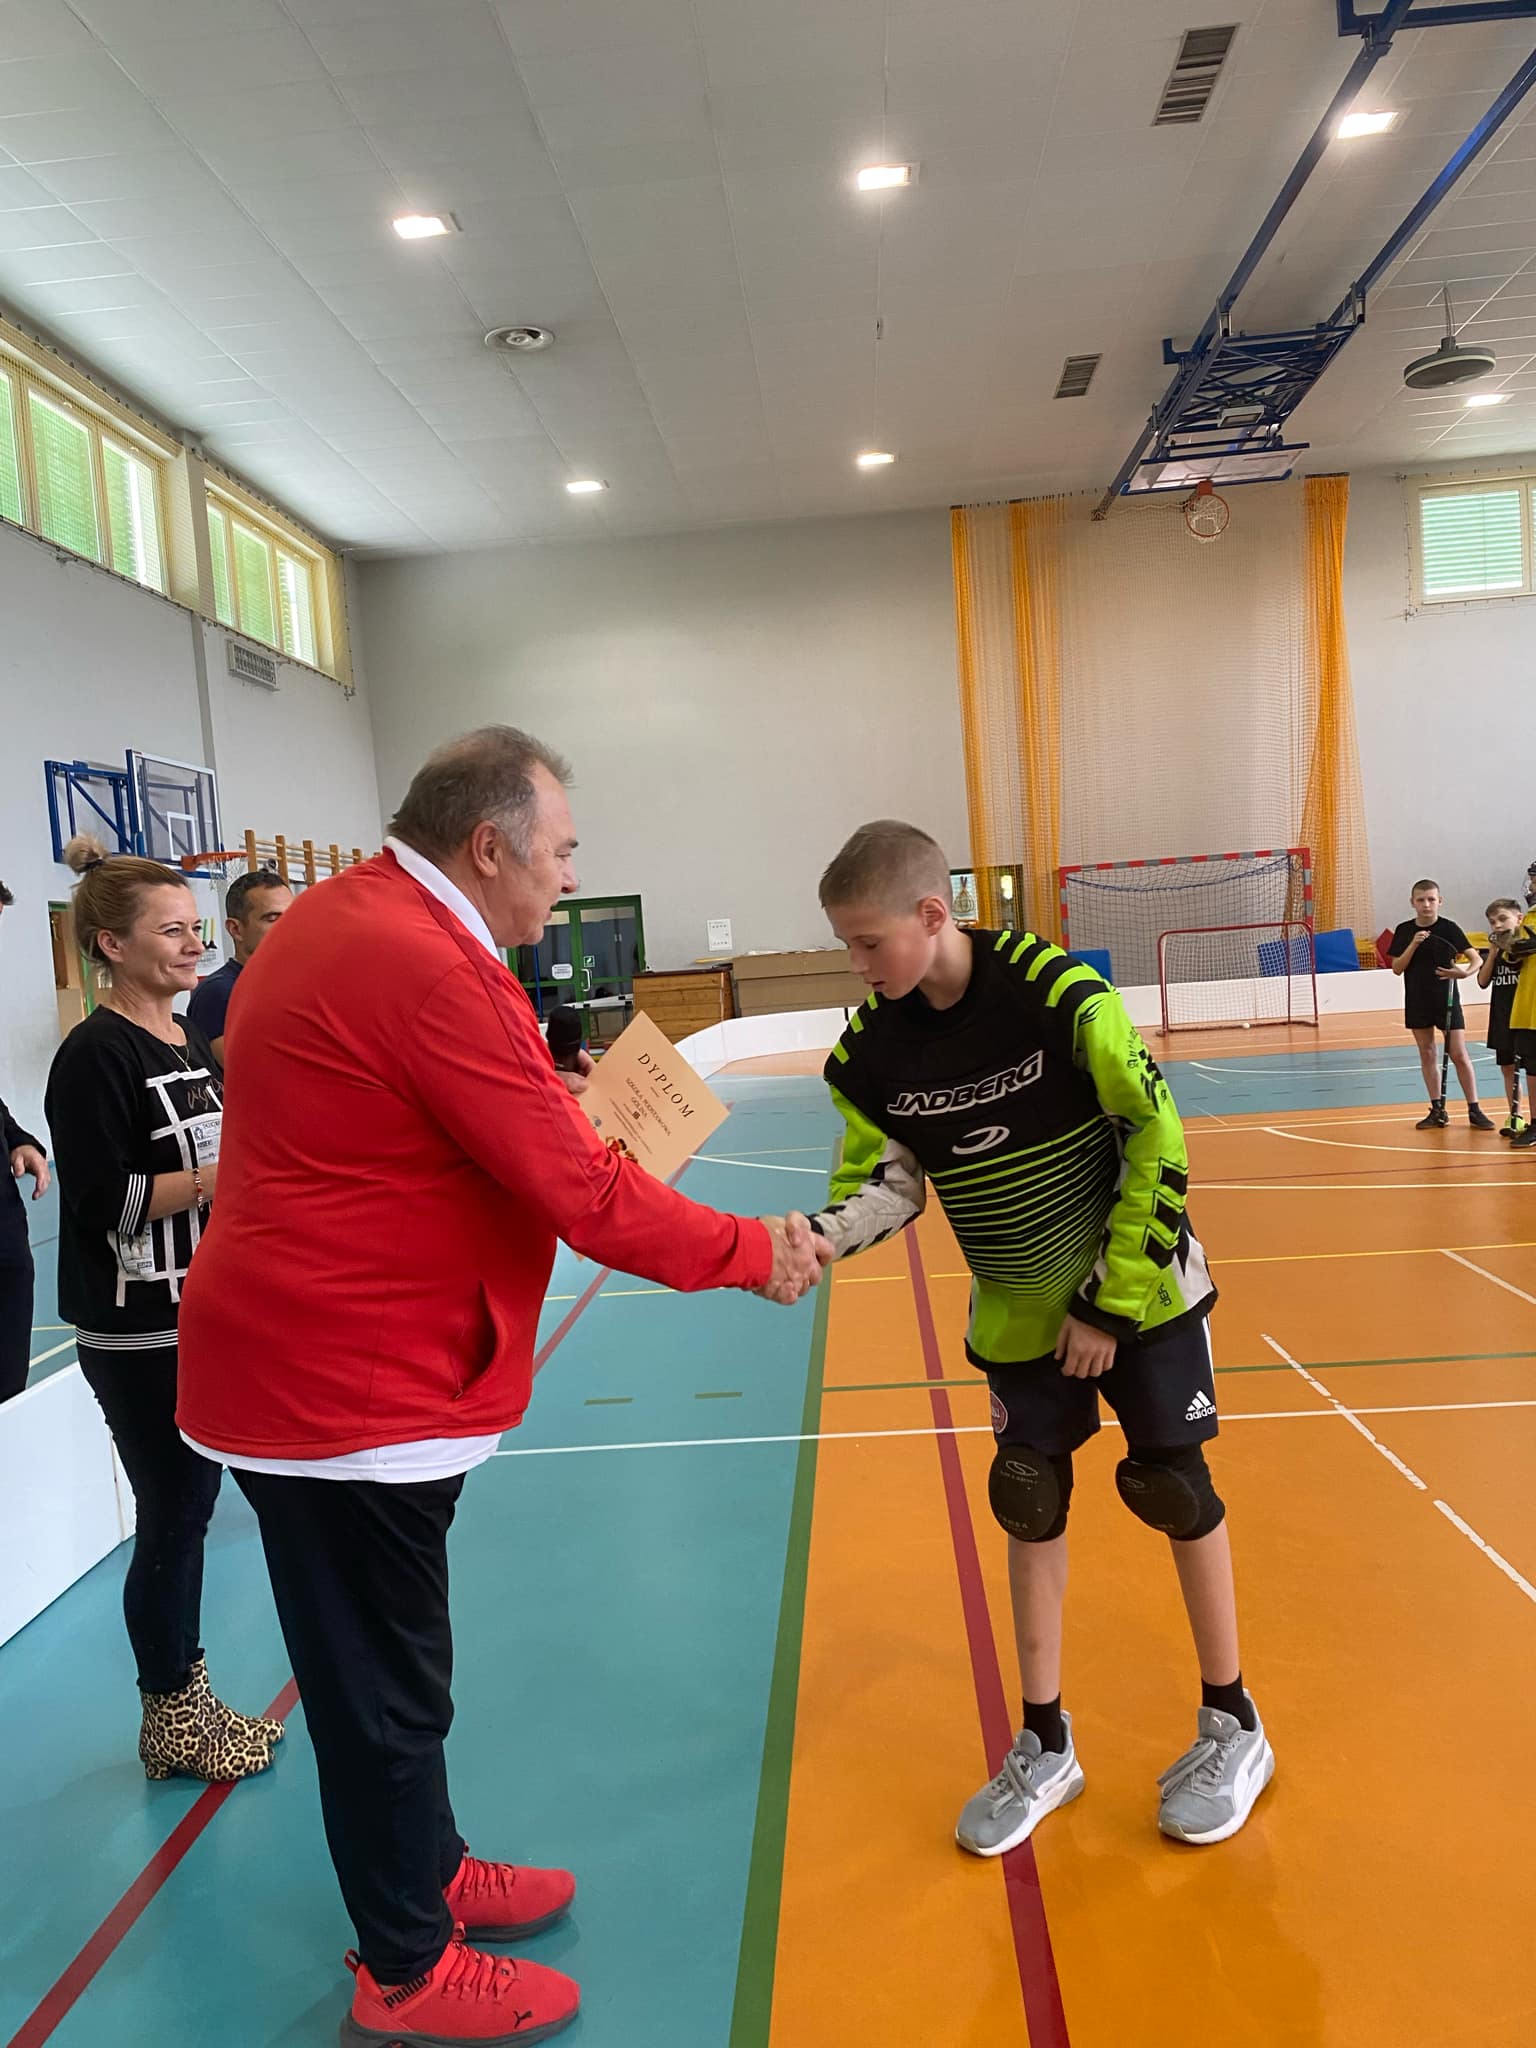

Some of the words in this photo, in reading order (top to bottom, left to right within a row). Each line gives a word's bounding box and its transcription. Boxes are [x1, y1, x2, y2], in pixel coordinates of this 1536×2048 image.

[638, 1053, 694, 1117] DYPLOM
[887, 1050, 1044, 1116] JADBERG
[1185, 1404, 1216, 1421] adidas
